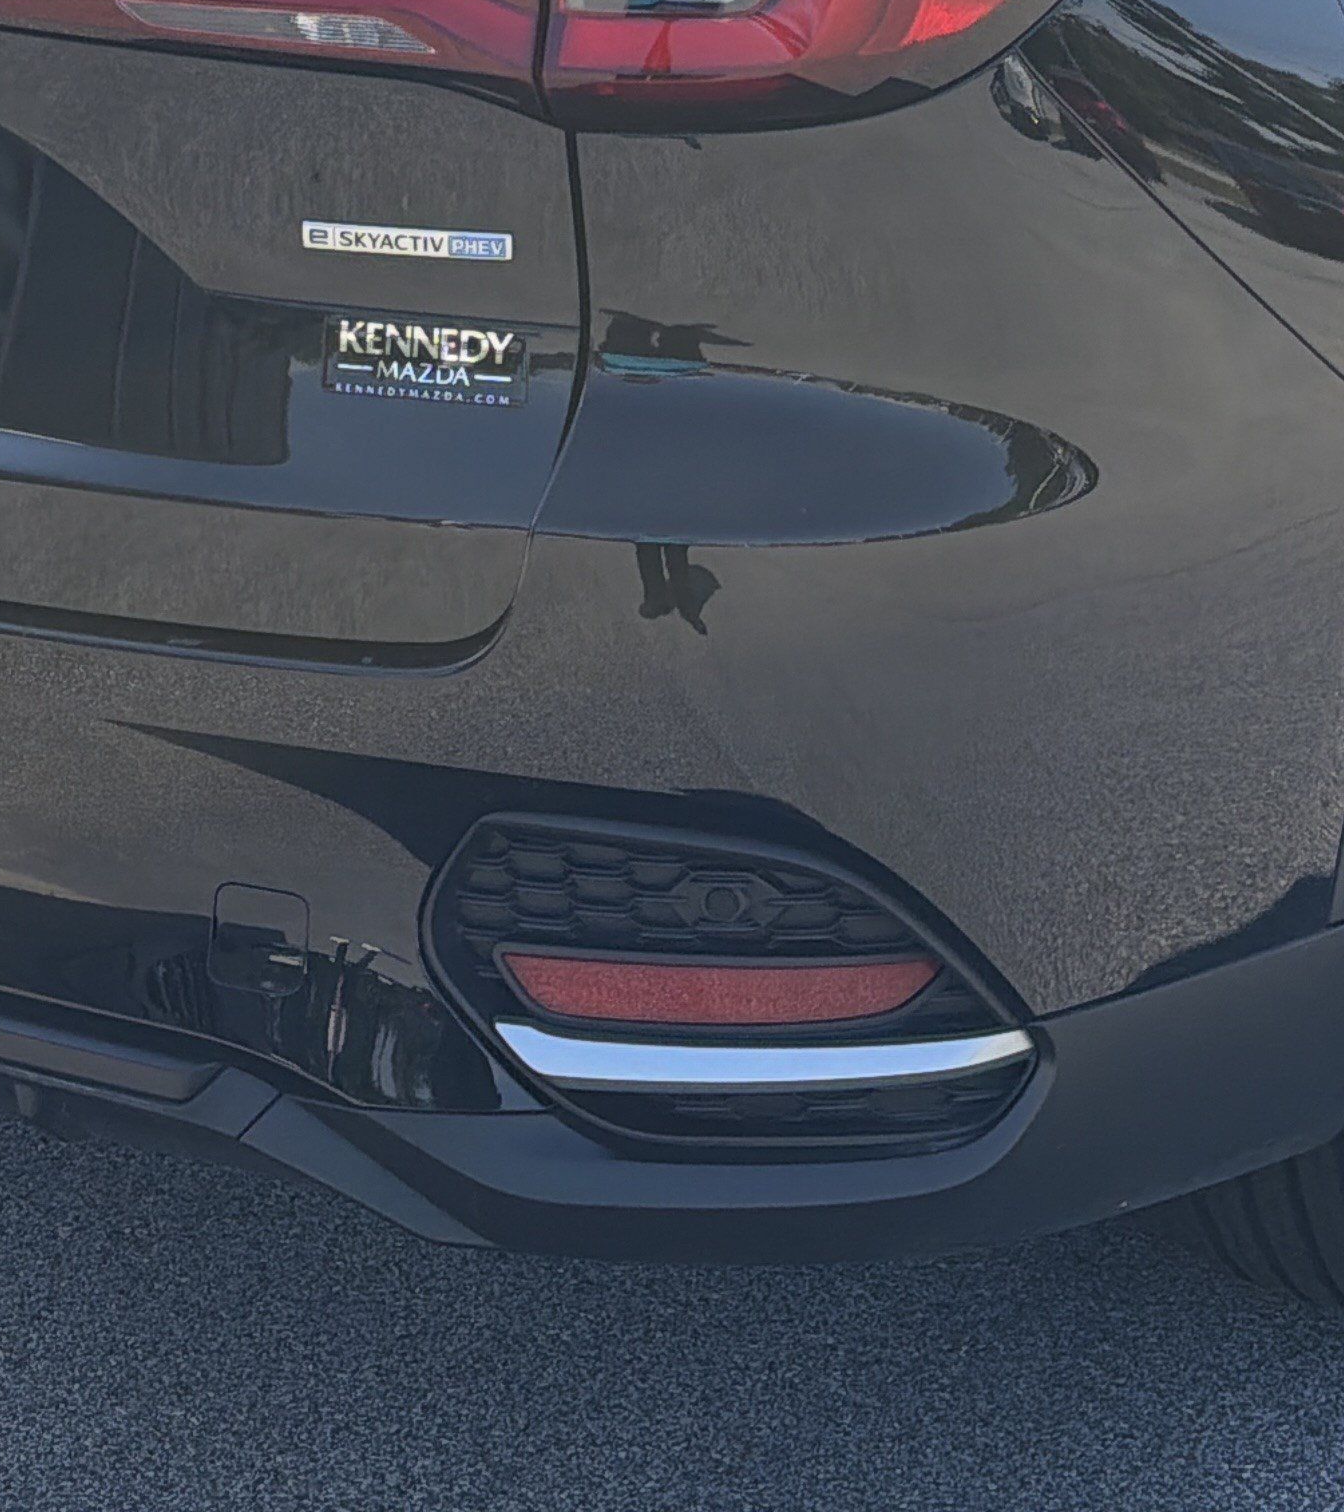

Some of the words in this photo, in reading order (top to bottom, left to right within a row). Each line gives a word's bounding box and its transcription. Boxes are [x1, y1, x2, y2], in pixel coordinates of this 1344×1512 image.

[339, 230, 444, 253] SKYACTIV
[451, 237, 504, 256] PHEV
[338, 319, 514, 365] KENNEDY
[376, 361, 471, 387] MAZDA
[335, 382, 511, 406] KENNEDYMAZDA.COM
